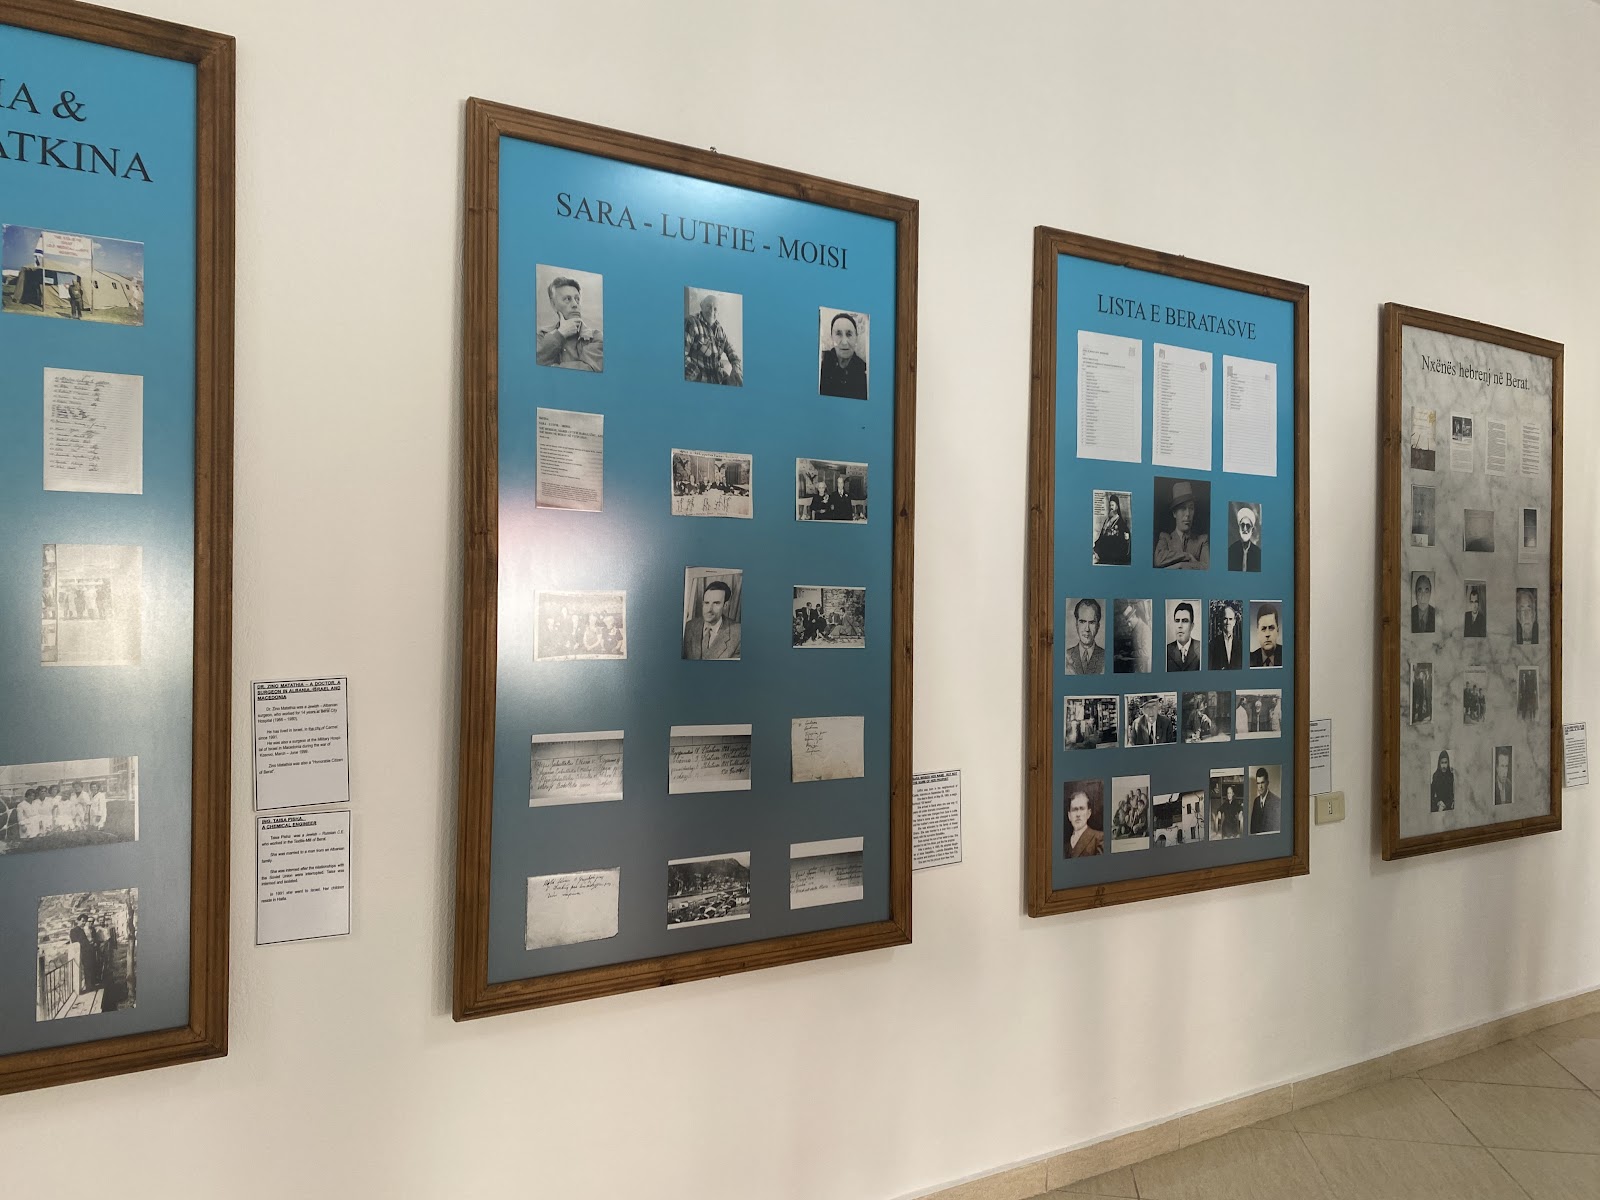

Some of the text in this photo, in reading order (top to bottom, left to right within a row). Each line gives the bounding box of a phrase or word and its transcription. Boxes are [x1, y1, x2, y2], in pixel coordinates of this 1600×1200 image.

[52, 91, 87, 122] &
[557, 192, 636, 230] SARA
[661, 213, 755, 252] LUTFIE
[778, 236, 848, 270] MOISI
[1098, 294, 1256, 340] LISTA E BERATASVE
[1422, 355, 1530, 390] Nxënës hebrenj në Berat.
